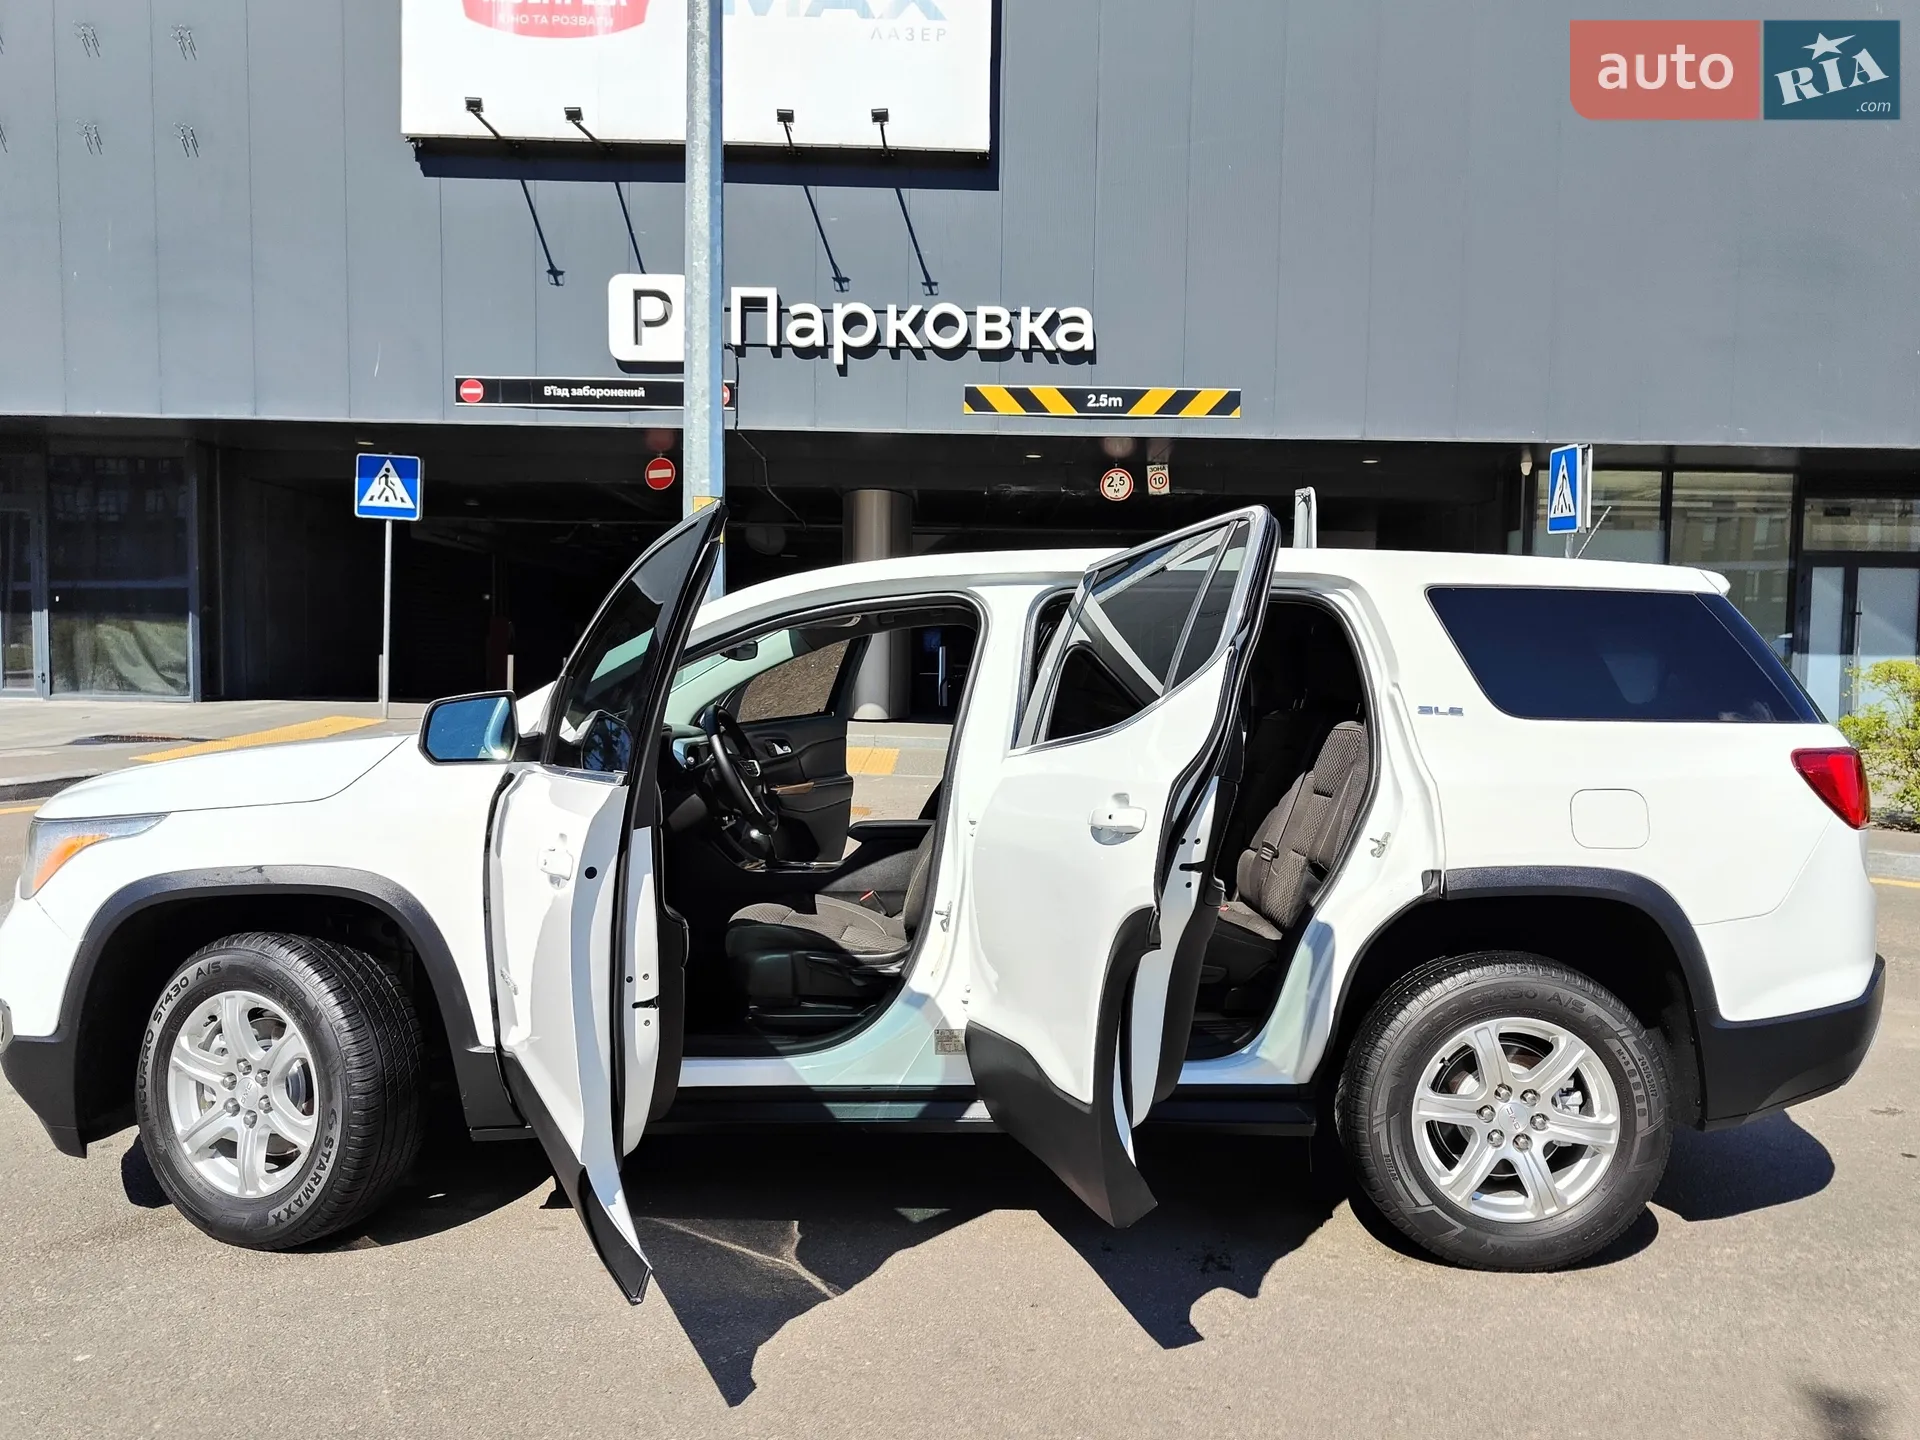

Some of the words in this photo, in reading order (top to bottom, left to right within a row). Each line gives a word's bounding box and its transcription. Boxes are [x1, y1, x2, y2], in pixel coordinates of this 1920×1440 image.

[532, 14, 548, 24] ТА
[551, 15, 613, 28] РОЗВАГИ
[870, 27, 948, 42] ЛАЗЕР
[633, 289, 673, 346] P
[730, 286, 1096, 366] Парковка
[543, 386, 570, 398] В'їзд
[570, 386, 646, 399] заборонений
[1086, 393, 1123, 408] 2.5m
[1106, 476, 1126, 488] 2,5
[1153, 477, 1164, 485] 10
[138, 1028, 155, 1123] INCURRO
[152, 975, 189, 1025] ST430
[195, 960, 222, 981] A/S
[271, 1135, 334, 1226] STARMAXX
